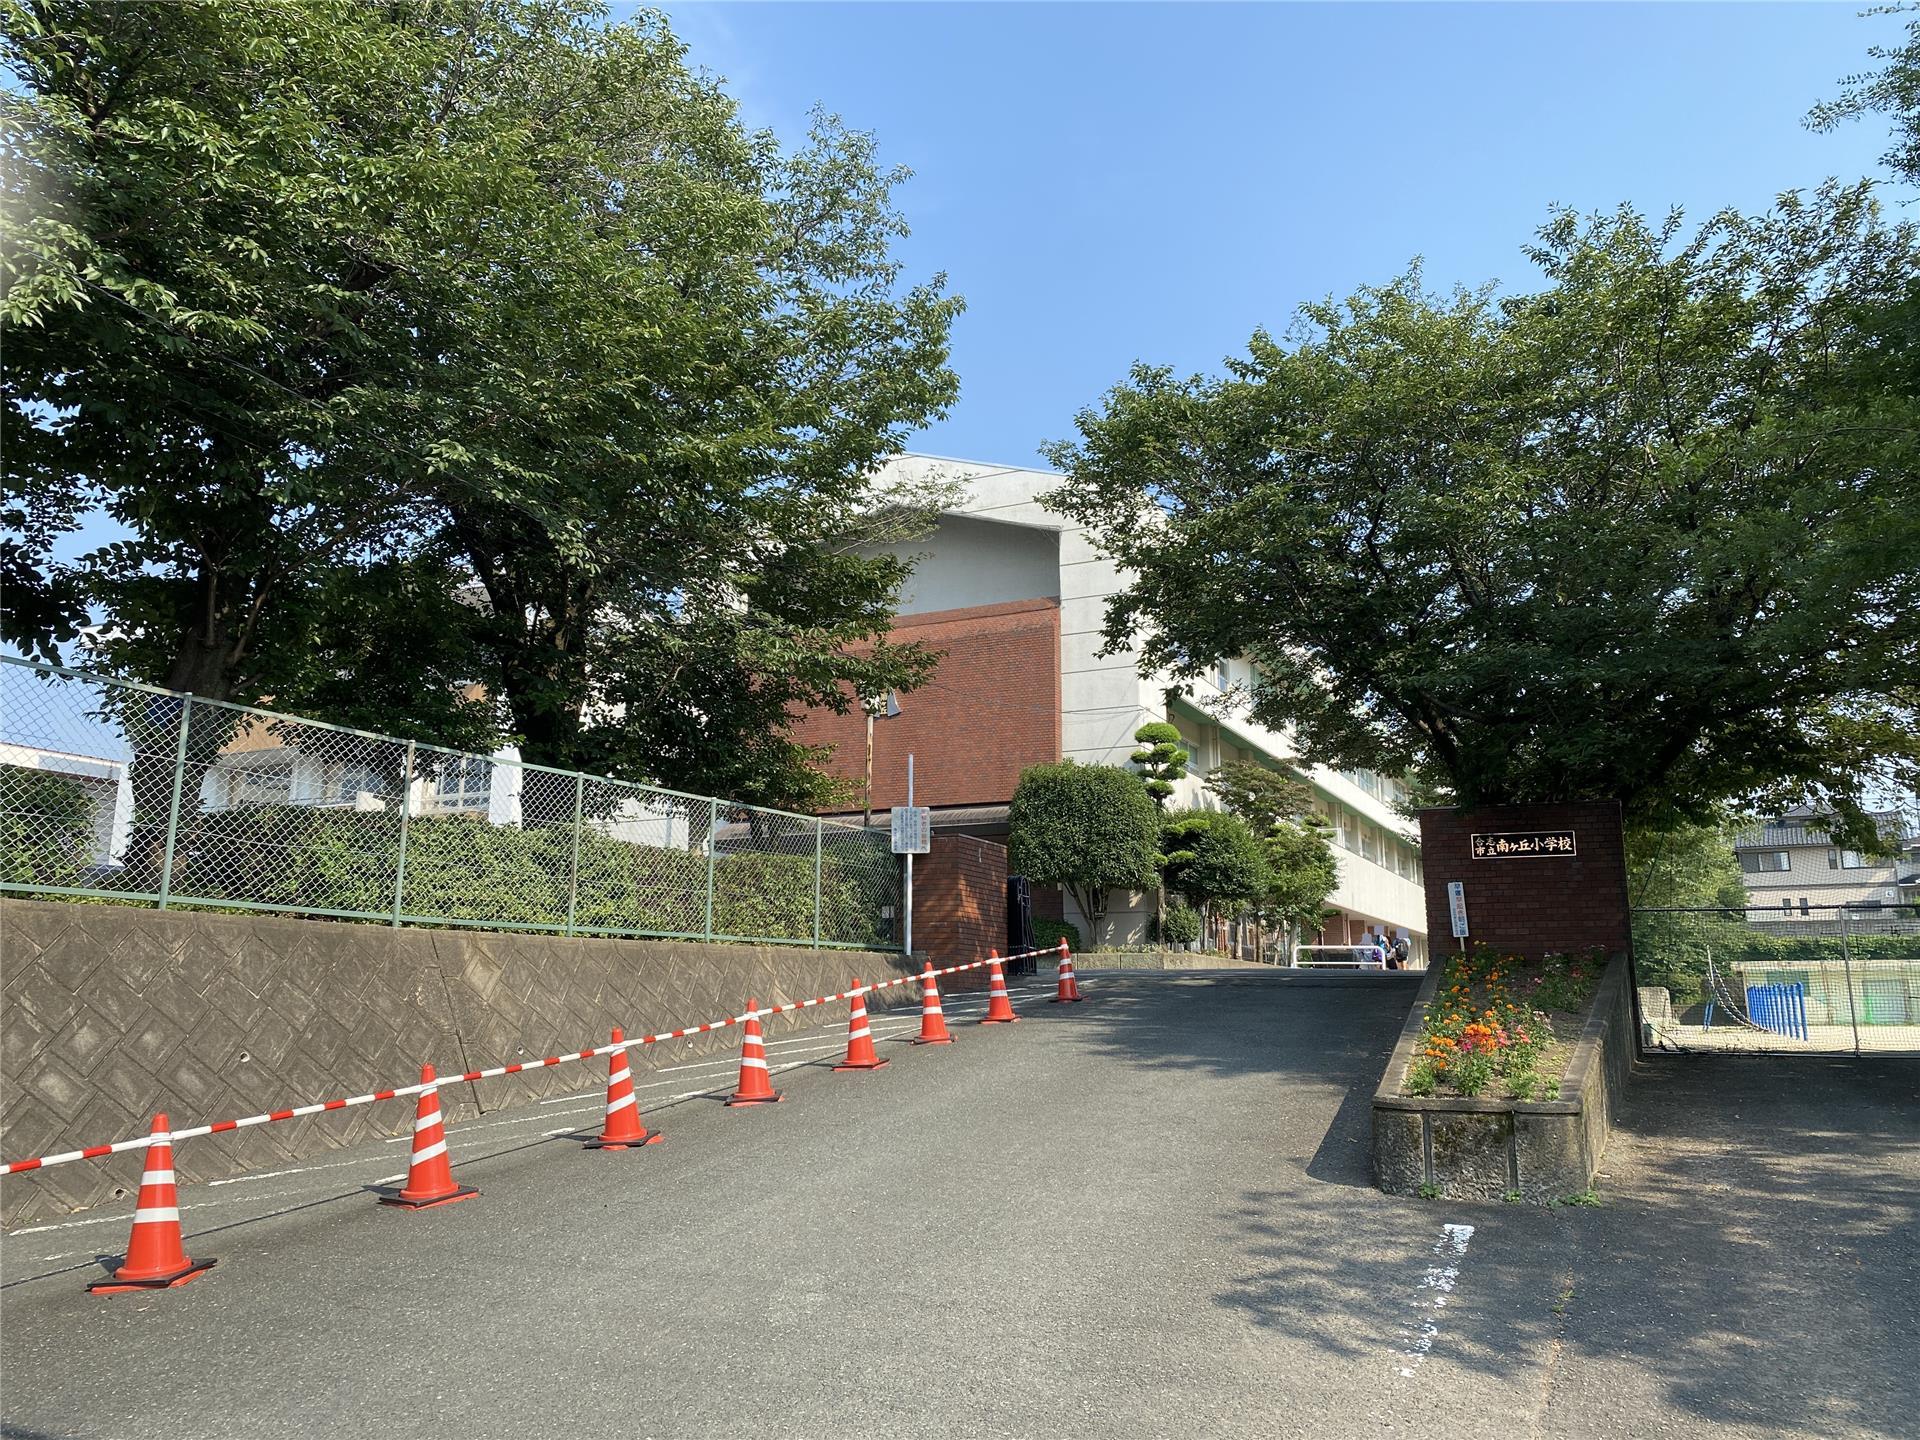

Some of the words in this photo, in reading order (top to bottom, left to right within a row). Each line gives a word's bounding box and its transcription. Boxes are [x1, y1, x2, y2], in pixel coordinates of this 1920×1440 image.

[1475, 846, 1497, 857] 市立
[1496, 836, 1573, 853] 南ヶ丘小学校
